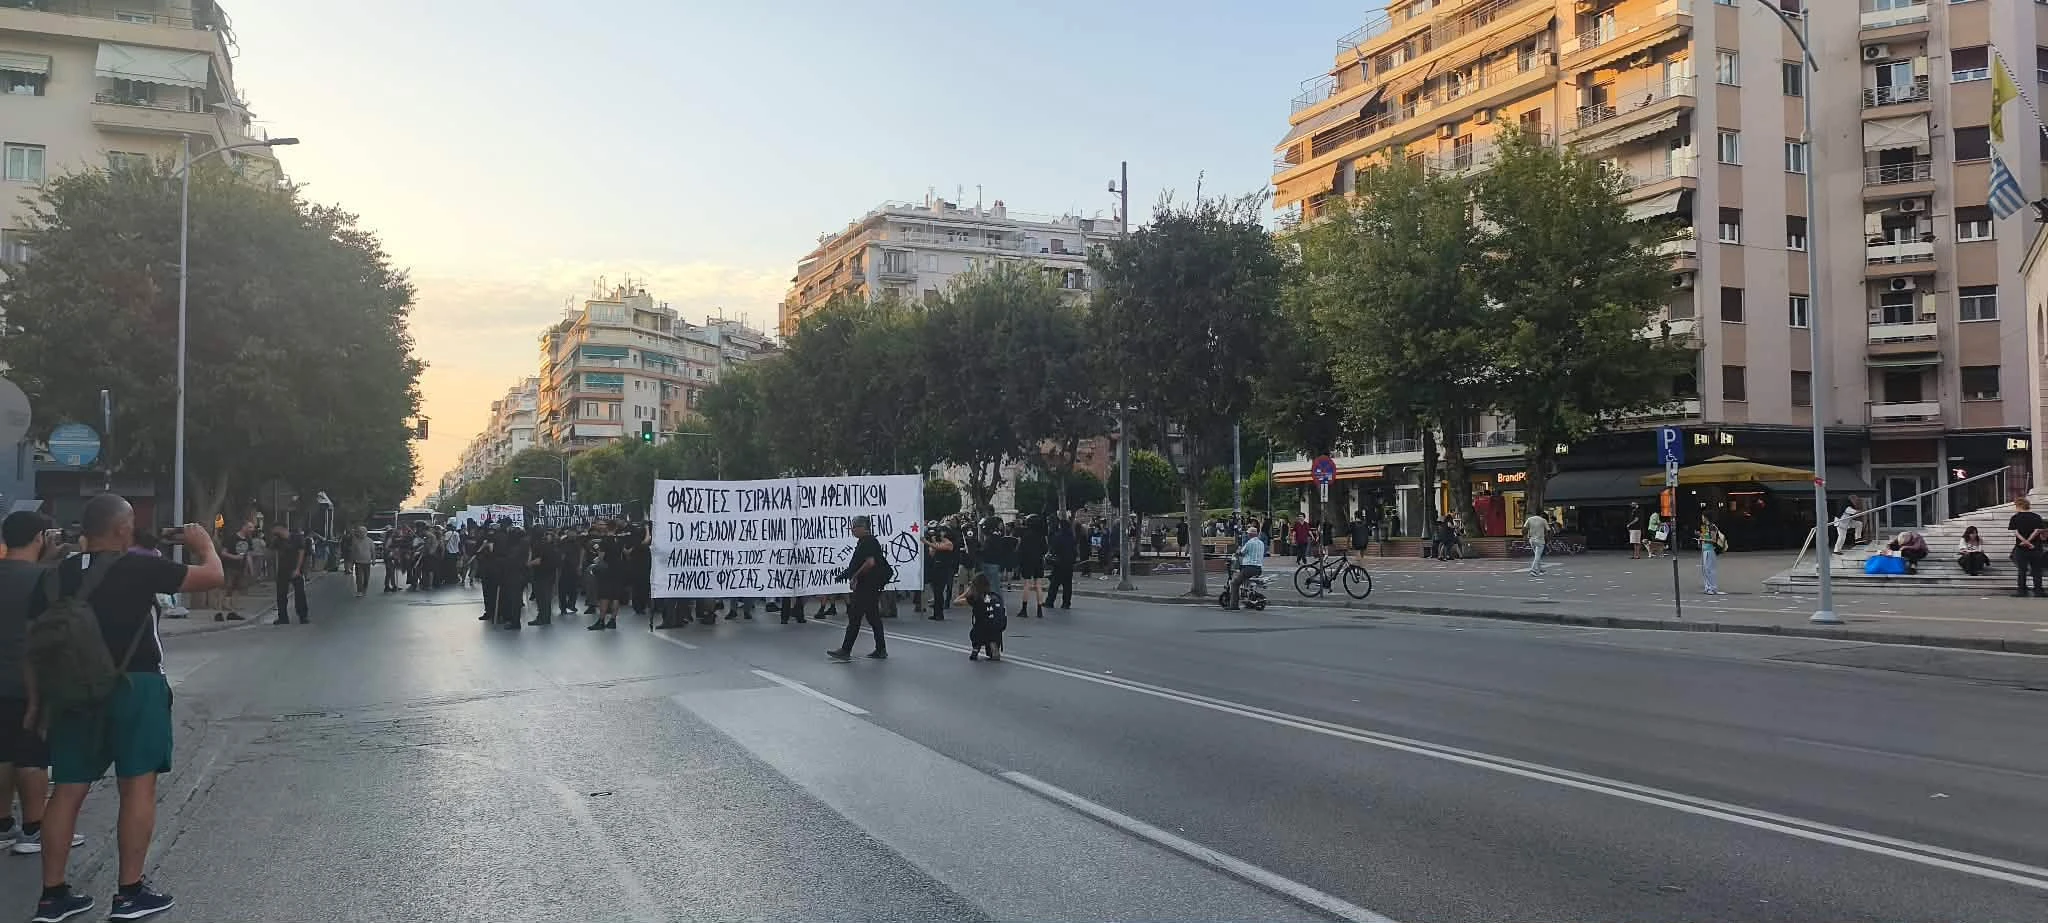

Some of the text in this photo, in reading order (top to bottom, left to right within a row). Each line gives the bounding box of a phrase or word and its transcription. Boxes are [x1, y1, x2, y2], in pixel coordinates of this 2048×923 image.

[1663, 428, 1676, 450] P
[667, 485, 730, 514] ΦΑΣΙΣΤΕΣ
[736, 485, 792, 512] ΤΣΙΡΑΚΙΑ
[820, 483, 887, 507] ΑΦΕΝΤΙΚΩΝ
[667, 513, 893, 543] ΤΟ ΜΕΛΛΟΝ ΣΑΣ ΕΙΝΑΙ ΠΡΟΔΙΑΓΕΓΡΑΕΝΟ
[667, 547, 734, 568] ΑΛΛΗΛΕΓΓΥΗ
[737, 549, 767, 565] ΣΤΟΥΣ
[769, 547, 836, 565] ΜΕΤΑΝΑΣΤΕΣ
[667, 571, 715, 591] ΠΑΥΛΟΣ
[716, 568, 765, 592] ΦΥΣΣΑΣ,
[767, 568, 807, 590] ΣΑΧΖΑΤ
